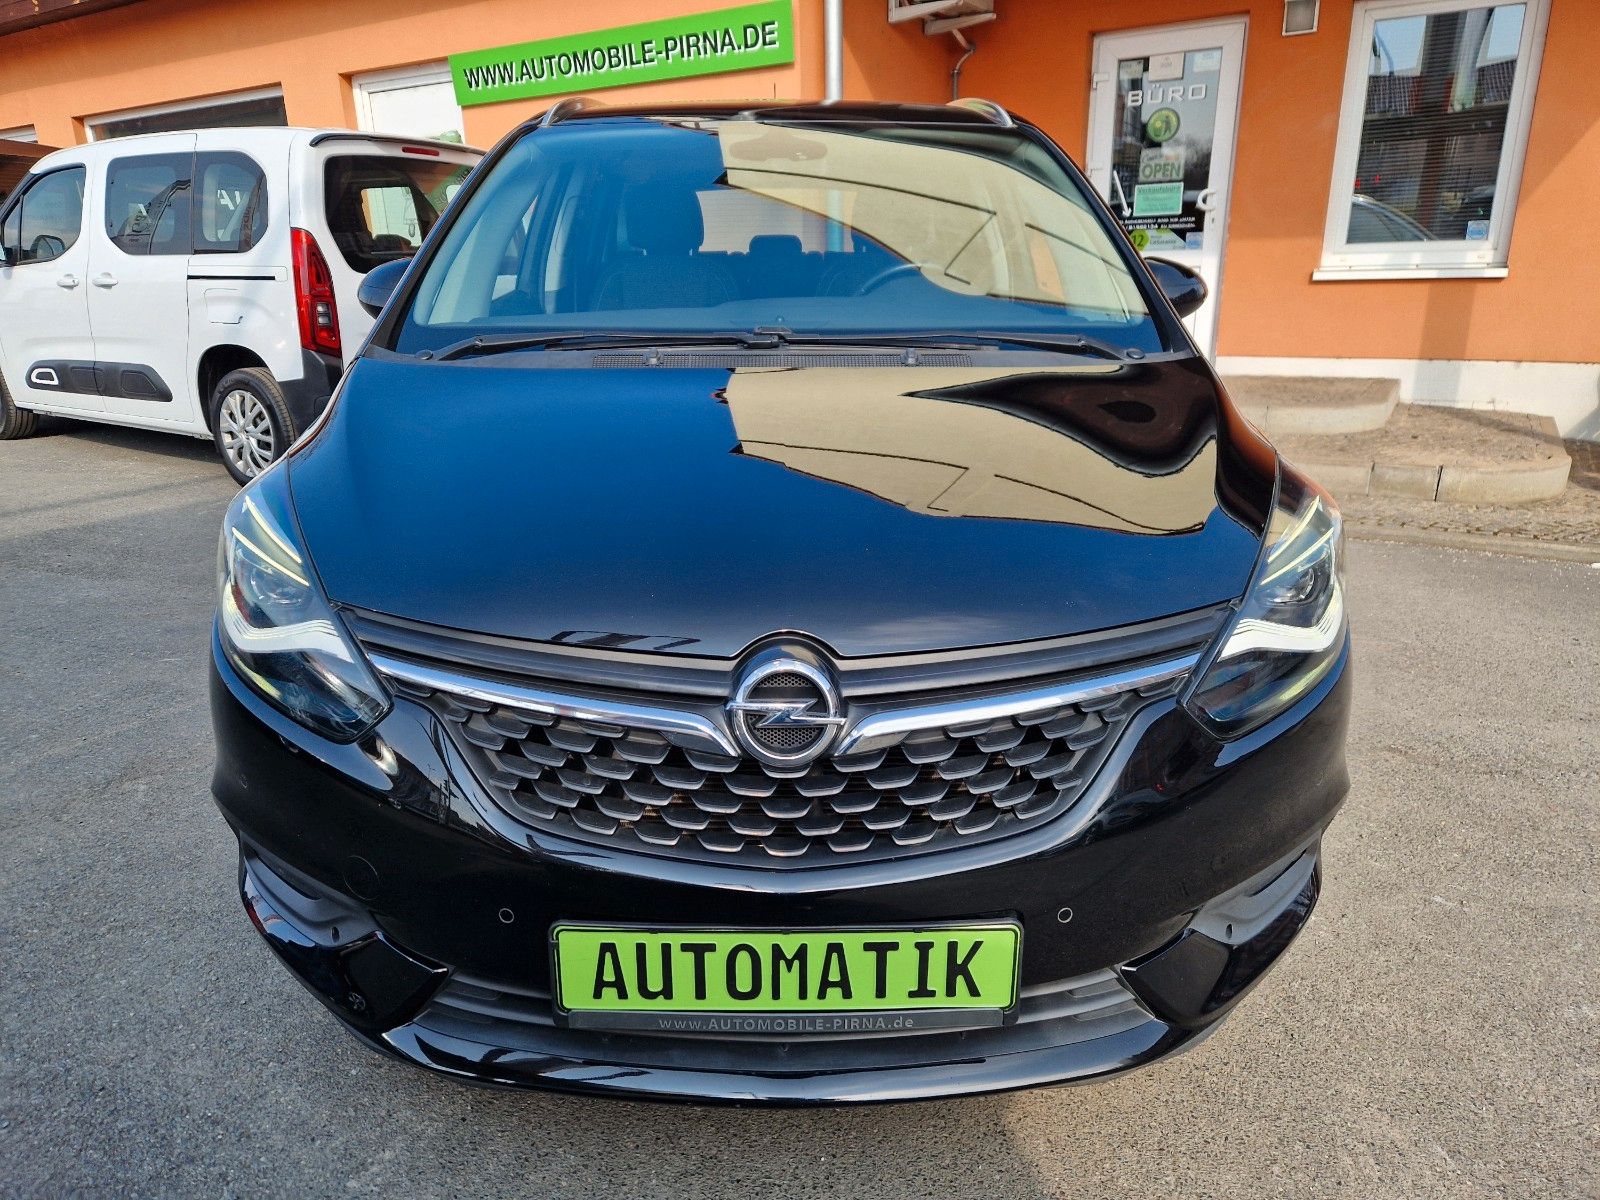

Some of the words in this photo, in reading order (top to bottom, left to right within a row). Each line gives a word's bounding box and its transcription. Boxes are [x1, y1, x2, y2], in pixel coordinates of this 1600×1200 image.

[463, 20, 778, 91] WWW.AUTOMOBILE-PIRNA.DE
[1127, 83, 1207, 107] BÜRO
[1141, 162, 1181, 180] OPEN
[592, 940, 985, 1001] AUTOMATIK
[658, 1016, 915, 1031] www.AUTOMOBILE-PIRNA.de
